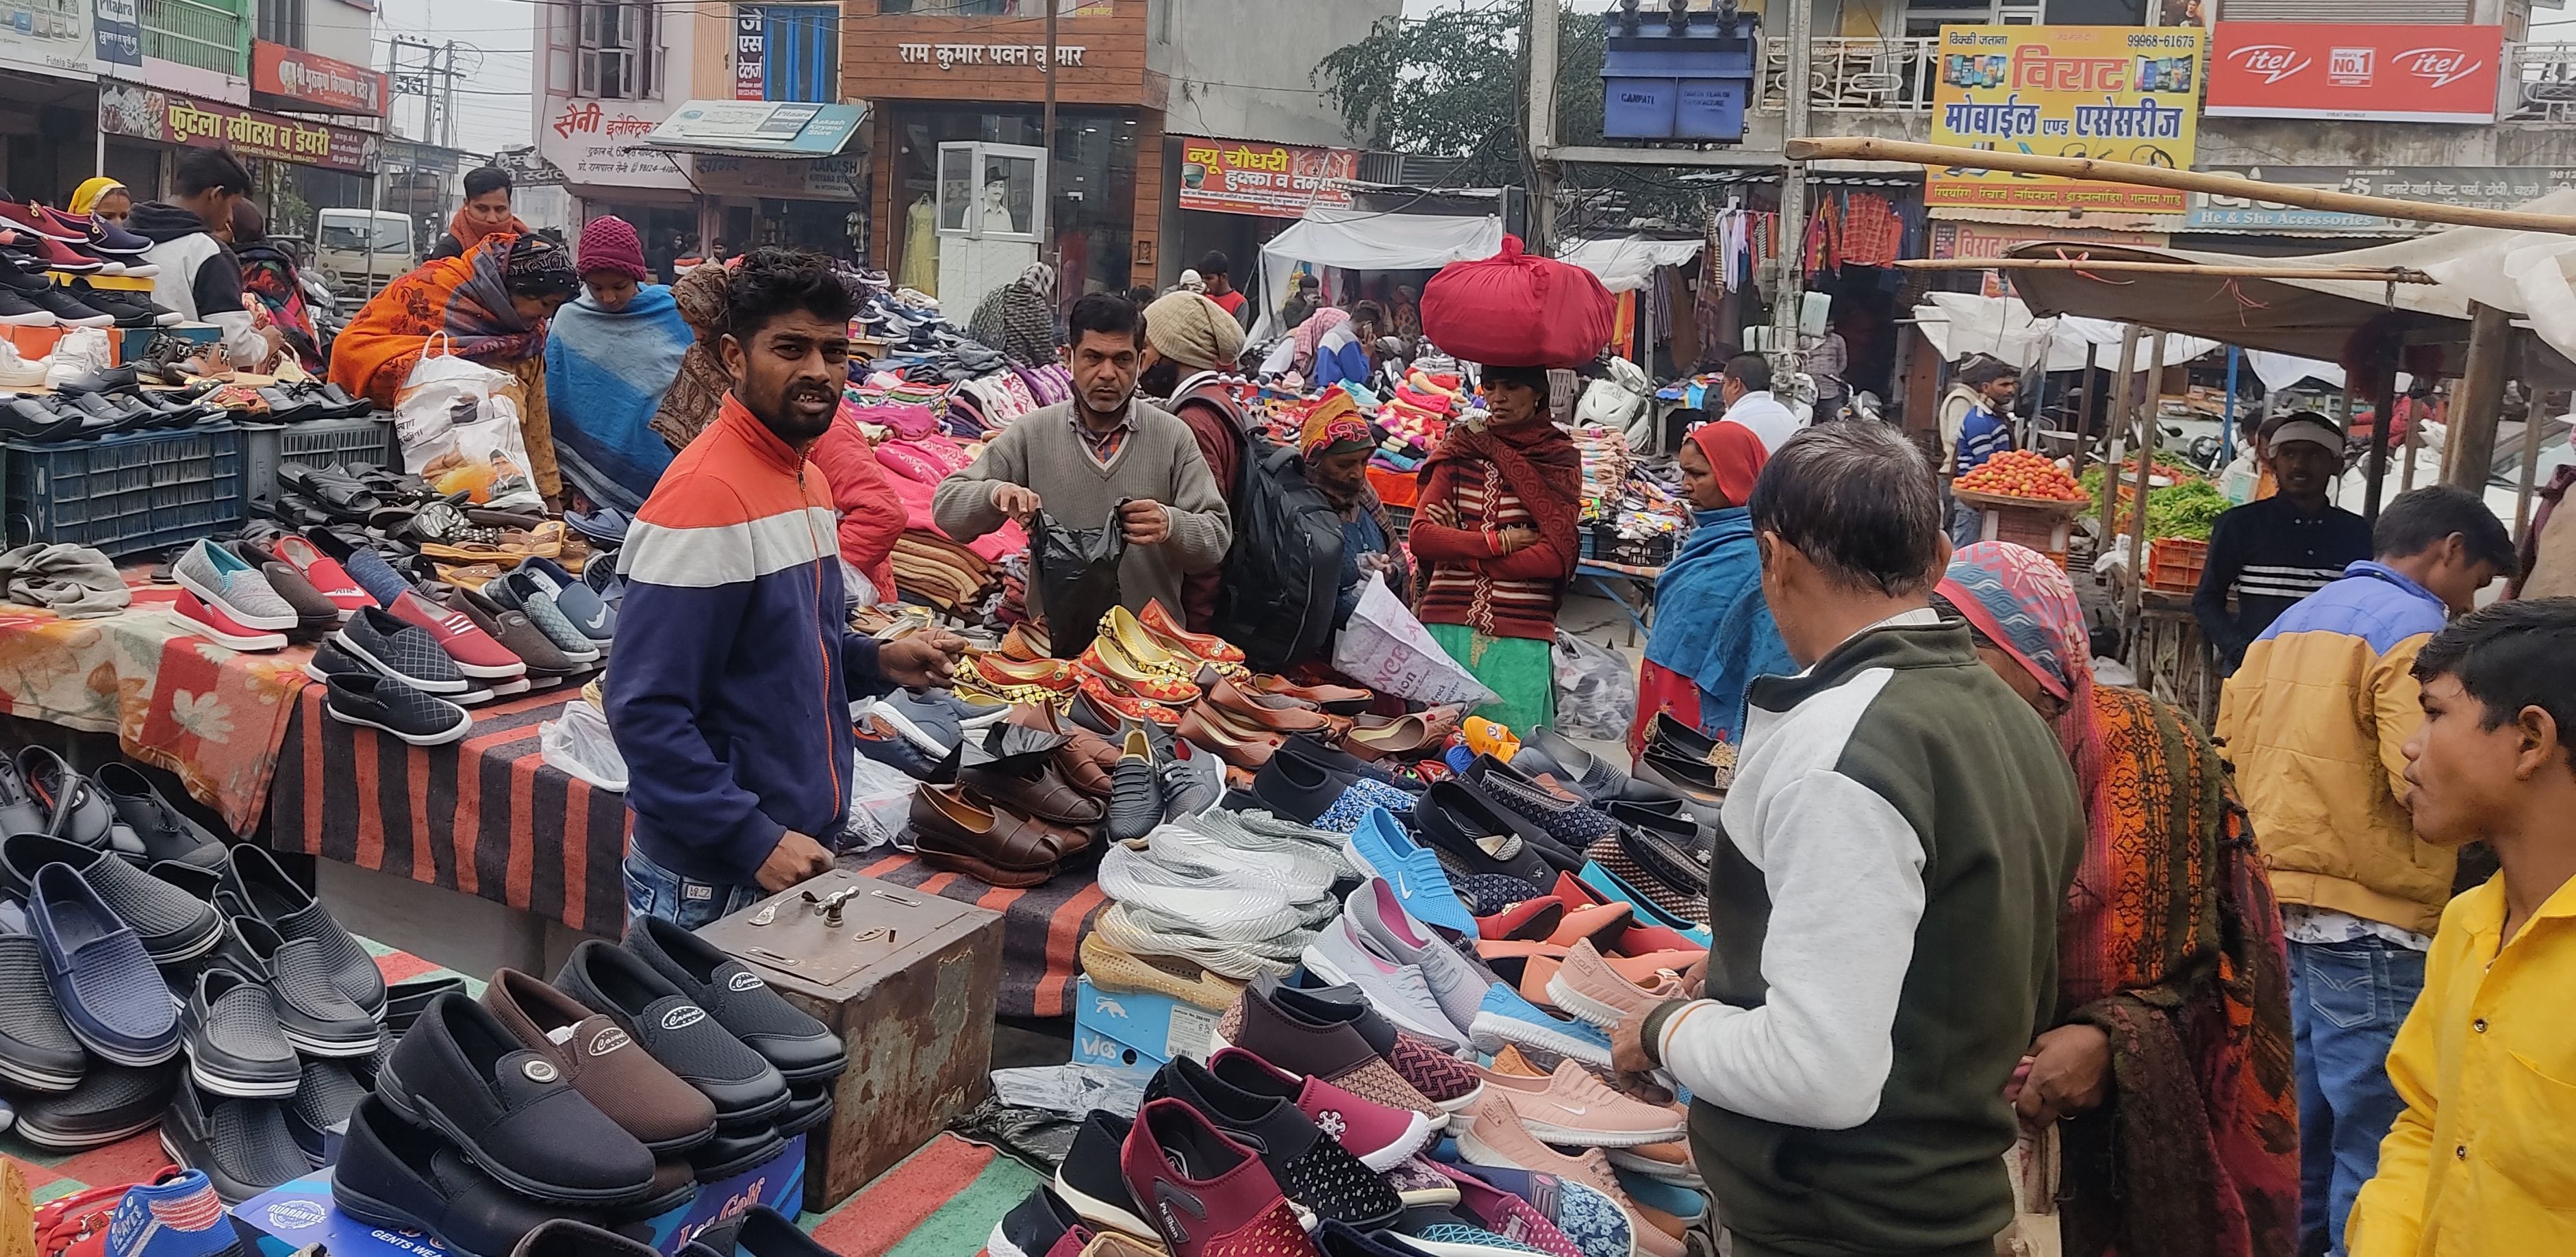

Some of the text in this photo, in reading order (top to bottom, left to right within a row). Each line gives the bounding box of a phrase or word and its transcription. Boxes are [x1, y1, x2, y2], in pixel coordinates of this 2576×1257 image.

[738, 35, 764, 53] एस
[1949, 31, 1977, 45] विक्की
[2127, 34, 2195, 48] 99968-61675
[46, 55, 88, 70] Futela Sweets
[898, 42, 931, 64] राम
[935, 43, 986, 70] कुमार
[987, 45, 1031, 66] पवन
[296, 62, 305, 86] श्री
[2011, 44, 2132, 92] विराट
[553, 103, 653, 141] सैनी इलैक्ट्रिक
[1945, 94, 2184, 140] मोबाईल एण्ड एसेसरीज
[168, 100, 223, 142] फुटेला
[279, 125, 294, 151] व
[292, 121, 330, 156] डैयरी
[808, 124, 844, 132] Kiryana
[589, 162, 614, 172] रामपाल
[1188, 144, 1289, 175] न्यू चौधरी
[1225, 169, 1273, 192] हुक्का
[1276, 173, 1290, 188] व
[2382, 180, 2409, 196] हमारे
[2200, 212, 2373, 227] He & She Accessories
[1958, 229, 2000, 258] विराट
[370, 1230, 414, 1249] GENTS
